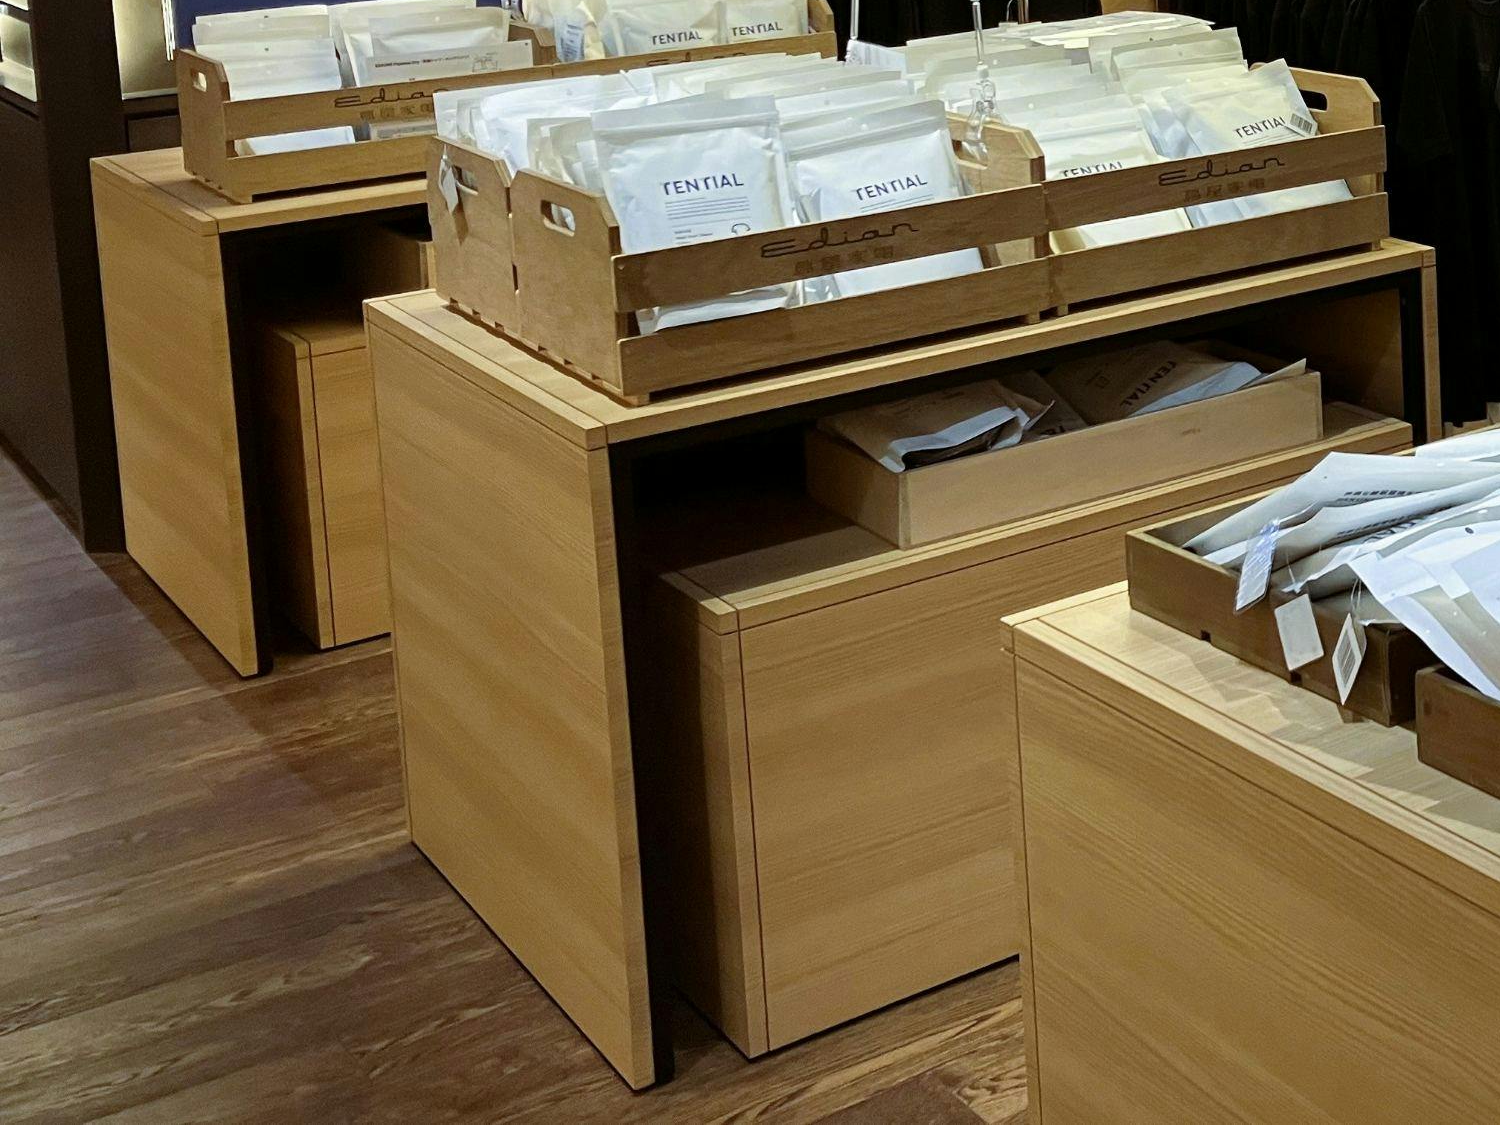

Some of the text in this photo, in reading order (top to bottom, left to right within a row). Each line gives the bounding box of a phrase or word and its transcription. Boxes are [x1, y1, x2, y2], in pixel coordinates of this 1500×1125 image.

[652, 30, 703, 46] TENTIAL
[732, 21, 784, 37] TENTIAL
[662, 173, 745, 196] TENTIAL
[855, 174, 928, 201] TENTIAL
[1118, 360, 1177, 409] TENTIAL
